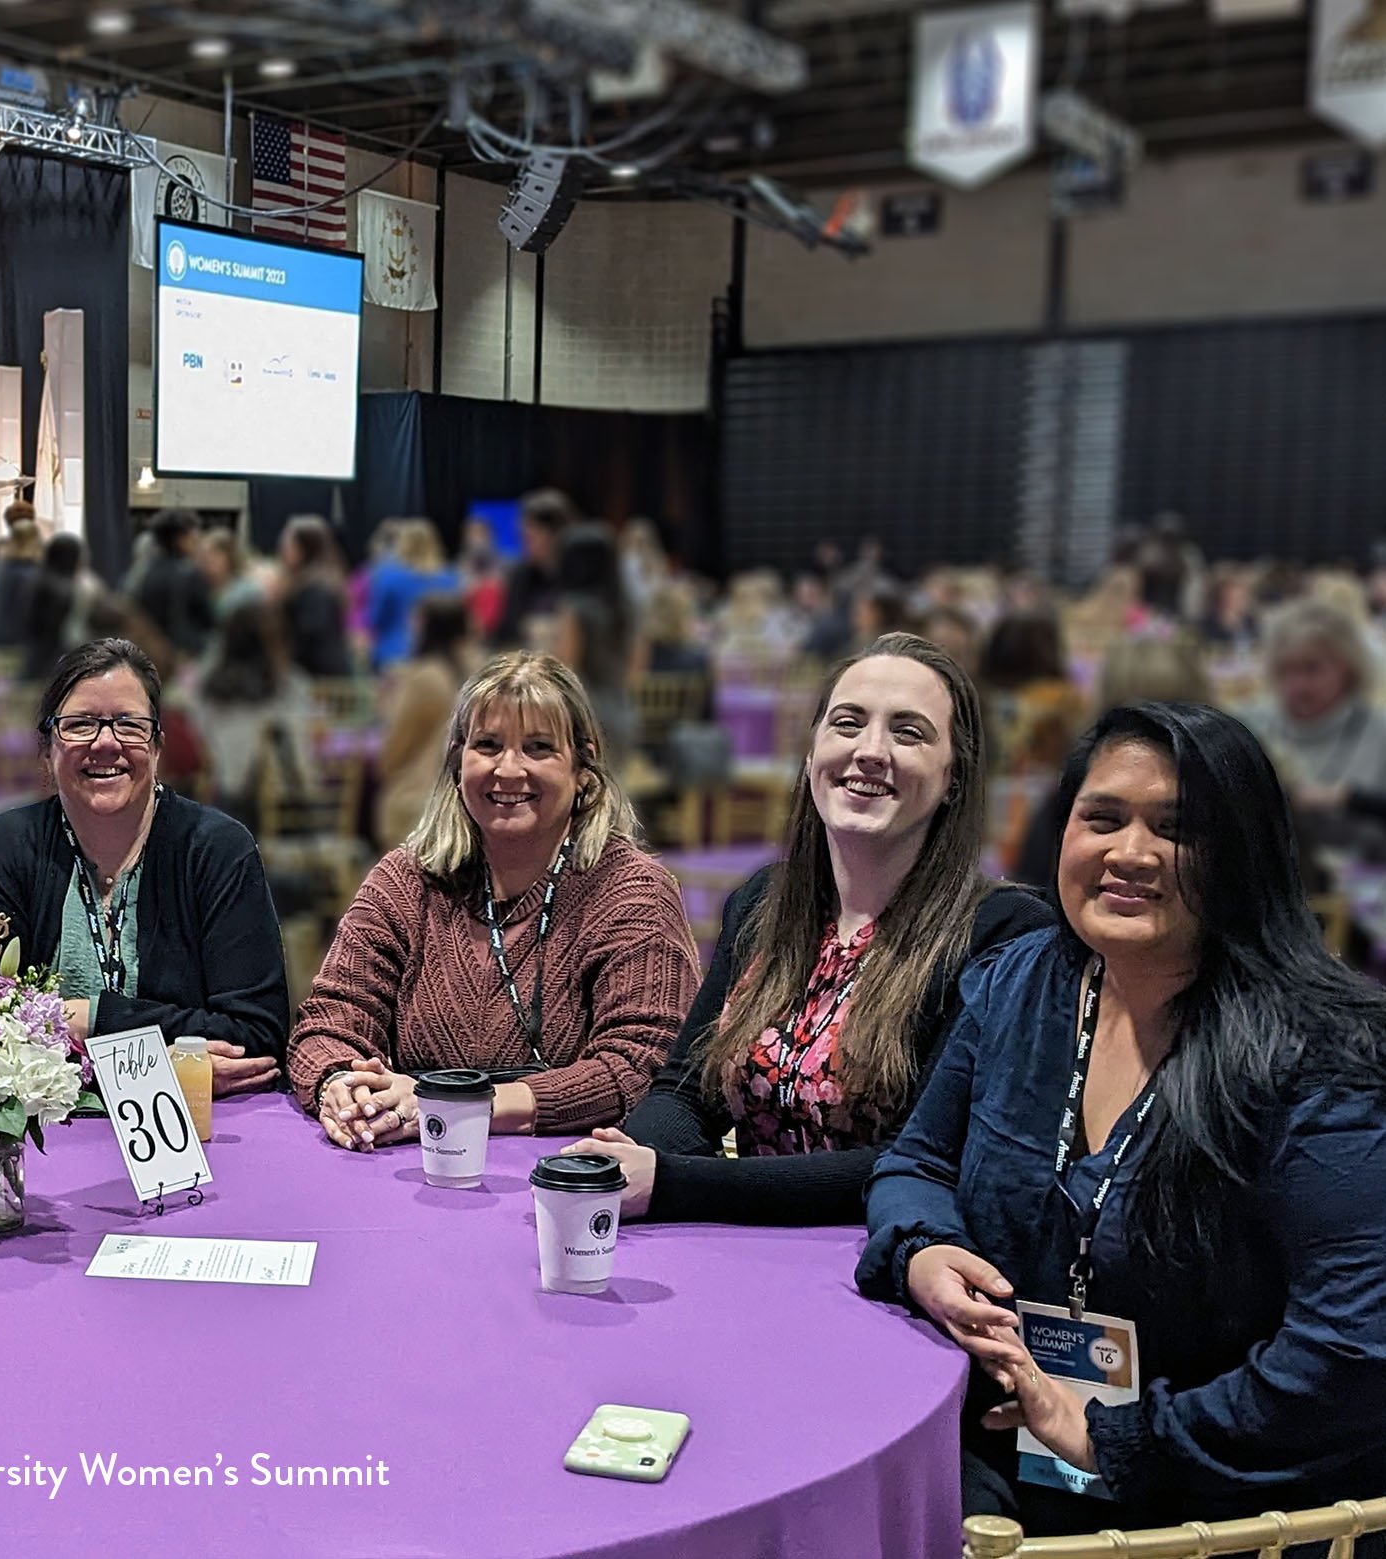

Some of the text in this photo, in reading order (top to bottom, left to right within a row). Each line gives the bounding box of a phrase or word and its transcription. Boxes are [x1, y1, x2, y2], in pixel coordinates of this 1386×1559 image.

[188, 255, 231, 276] WOMEN'S
[232, 262, 265, 281] SUMMIT
[183, 353, 203, 369] PBN
[1085, 989, 1097, 1019] Amica
[1078, 1031, 1092, 1060] Amica
[99, 1038, 158, 1091] Table
[1068, 1071, 1083, 1099] Amica
[1137, 1092, 1155, 1123] Amica
[117, 1091, 188, 1162] 30
[1056, 1140, 1069, 1171] Amica
[1114, 1134, 1133, 1165] Amica
[1094, 1178, 1112, 1209] Amica
[564, 1246, 601, 1256] Women's
[1030, 1325, 1086, 1345] WOMEN'S
[1030, 1334, 1075, 1353] SUMMIT
[1099, 1352, 1114, 1365] 16
